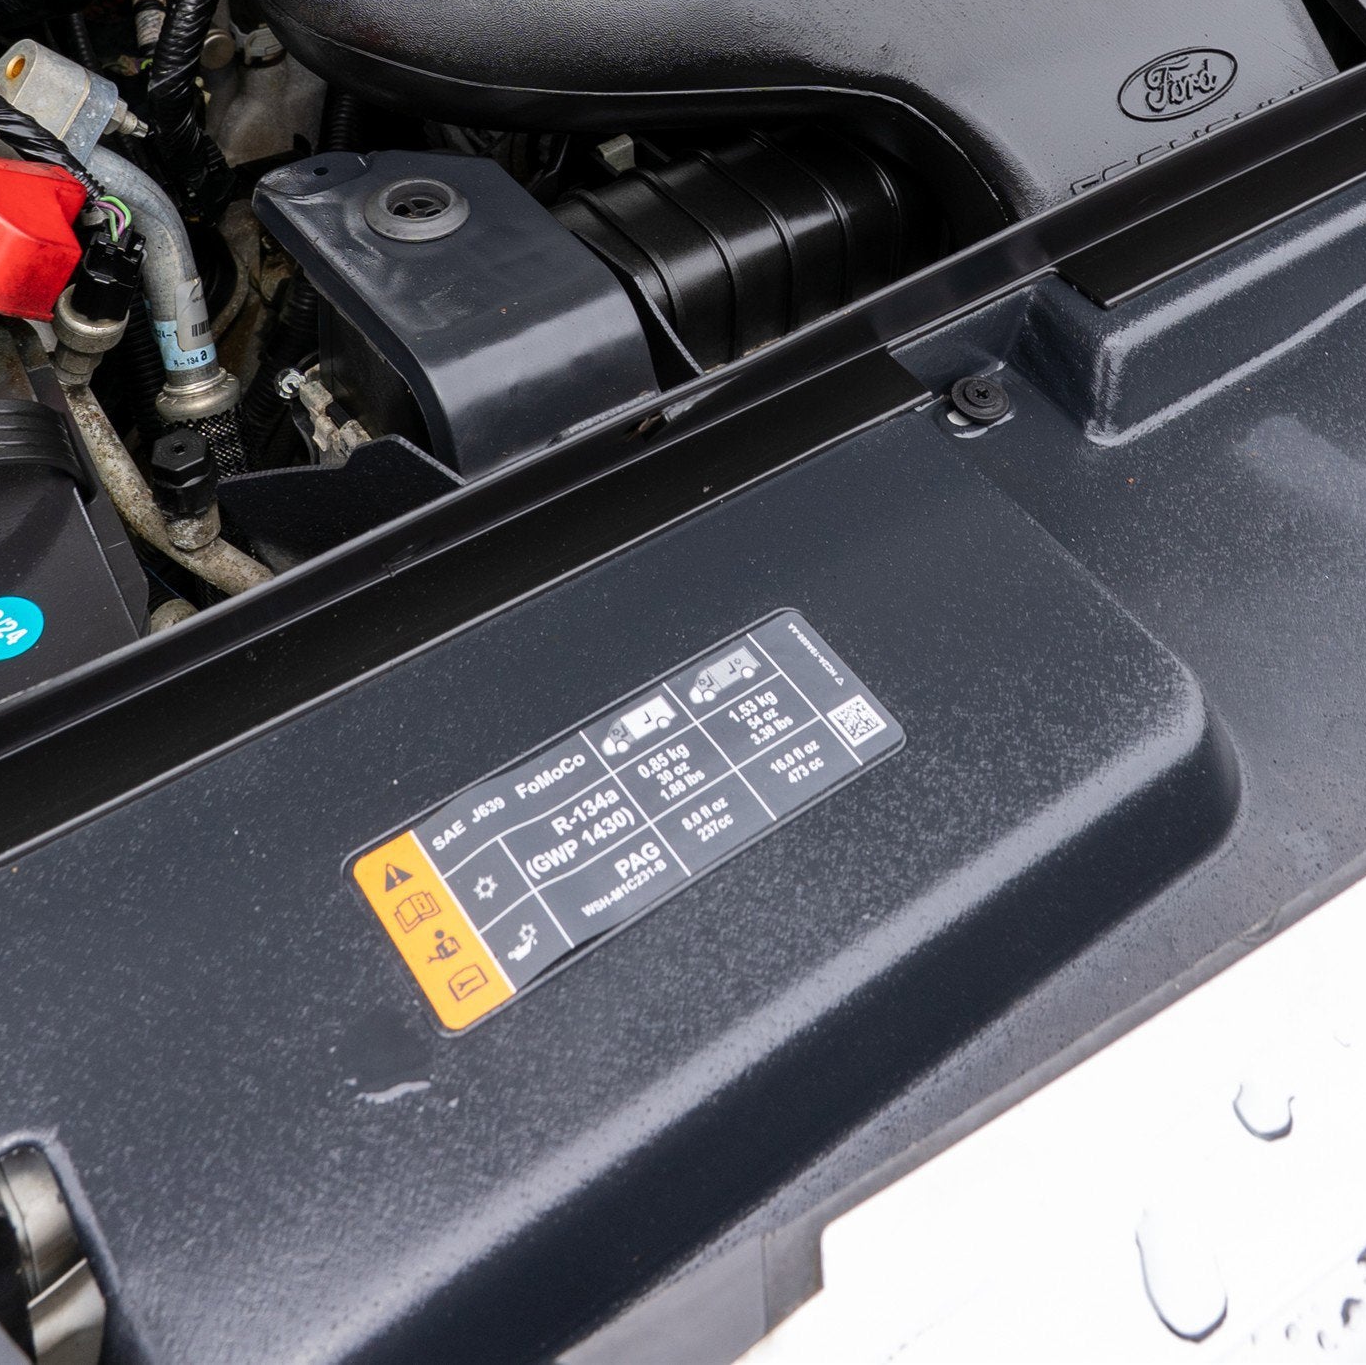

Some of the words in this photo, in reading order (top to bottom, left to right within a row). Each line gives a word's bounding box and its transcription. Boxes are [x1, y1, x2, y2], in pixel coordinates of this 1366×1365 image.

[728, 700, 758, 723] 1.53
[755, 691, 779, 707] kg
[746, 715, 764, 730] 54
[762, 707, 779, 722] oz
[773, 716, 794, 732] lbs
[637, 753, 670, 779] 0.85
[666, 743, 691, 761] kg
[656, 769, 674, 786] 30
[673, 761, 691, 776] oz
[770, 753, 796, 774] 16.0
[792, 746, 806, 761] fl
[803, 740, 821, 755] oz
[787, 764, 810, 784] 473
[808, 757, 825, 772] cc
[683, 769, 706, 787] lbs
[432, 819, 467, 851] SAE
[471, 796, 506, 823] J639
[514, 753, 586, 799] FoMoCo
[551, 789, 620, 836] R-134a
[681, 811, 702, 831] 8.0
[700, 805, 713, 819] fl
[711, 797, 729, 813] oz
[526, 838, 579, 880] (GWP
[581, 806, 635, 847] 1430)
[696, 814, 734, 842] 237cc
[614, 841, 661, 879] PAG
